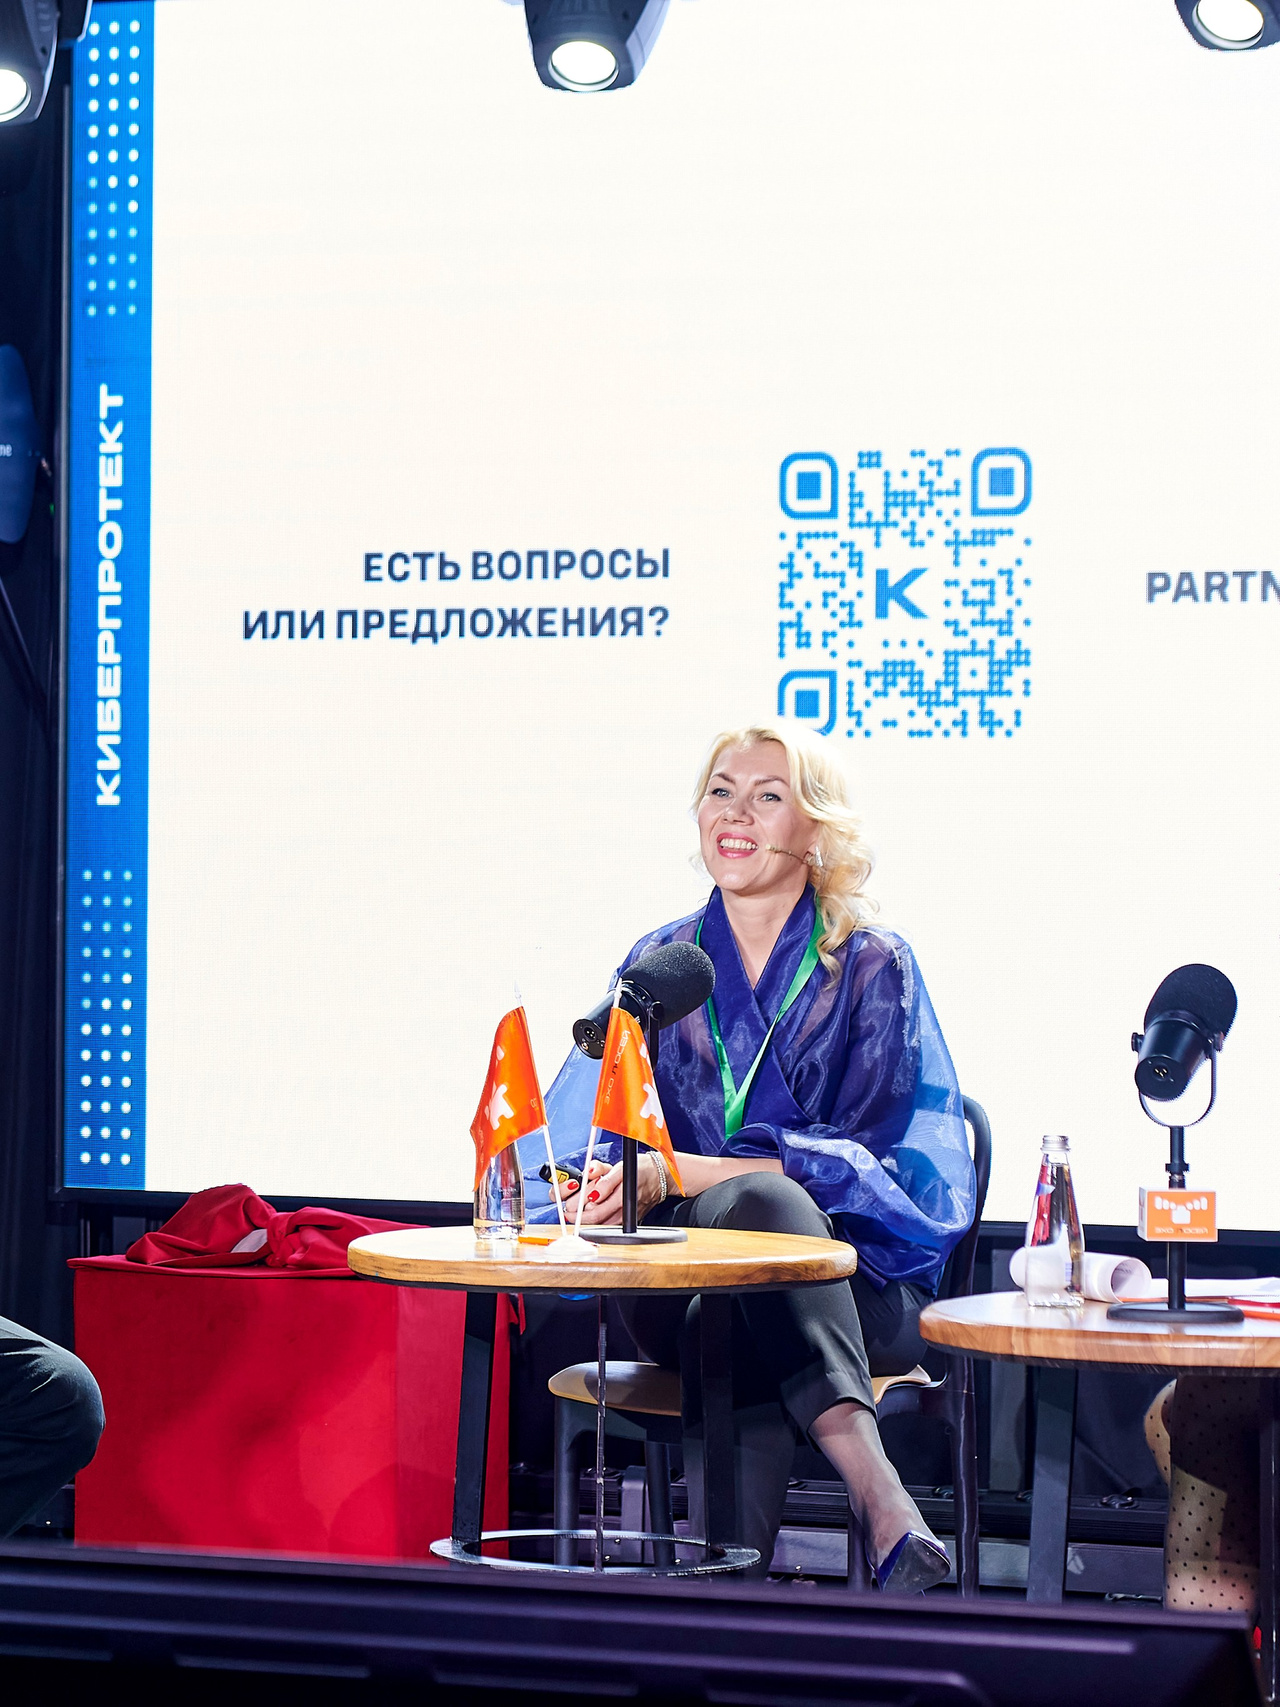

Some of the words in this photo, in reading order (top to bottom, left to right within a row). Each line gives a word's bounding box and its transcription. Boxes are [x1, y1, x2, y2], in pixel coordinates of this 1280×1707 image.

[364, 551, 461, 583] ЕСТЬ
[471, 548, 669, 581] ВОПРОСЫ
[96, 383, 124, 806] КИБЕРПРОТЕКТ
[1147, 570, 1280, 603] PARTN
[243, 609, 325, 640] ИЛИ
[336, 605, 669, 645] ПРЕДЛОЖЕНИЯ?
[604, 1078, 615, 1105] ЭХО
